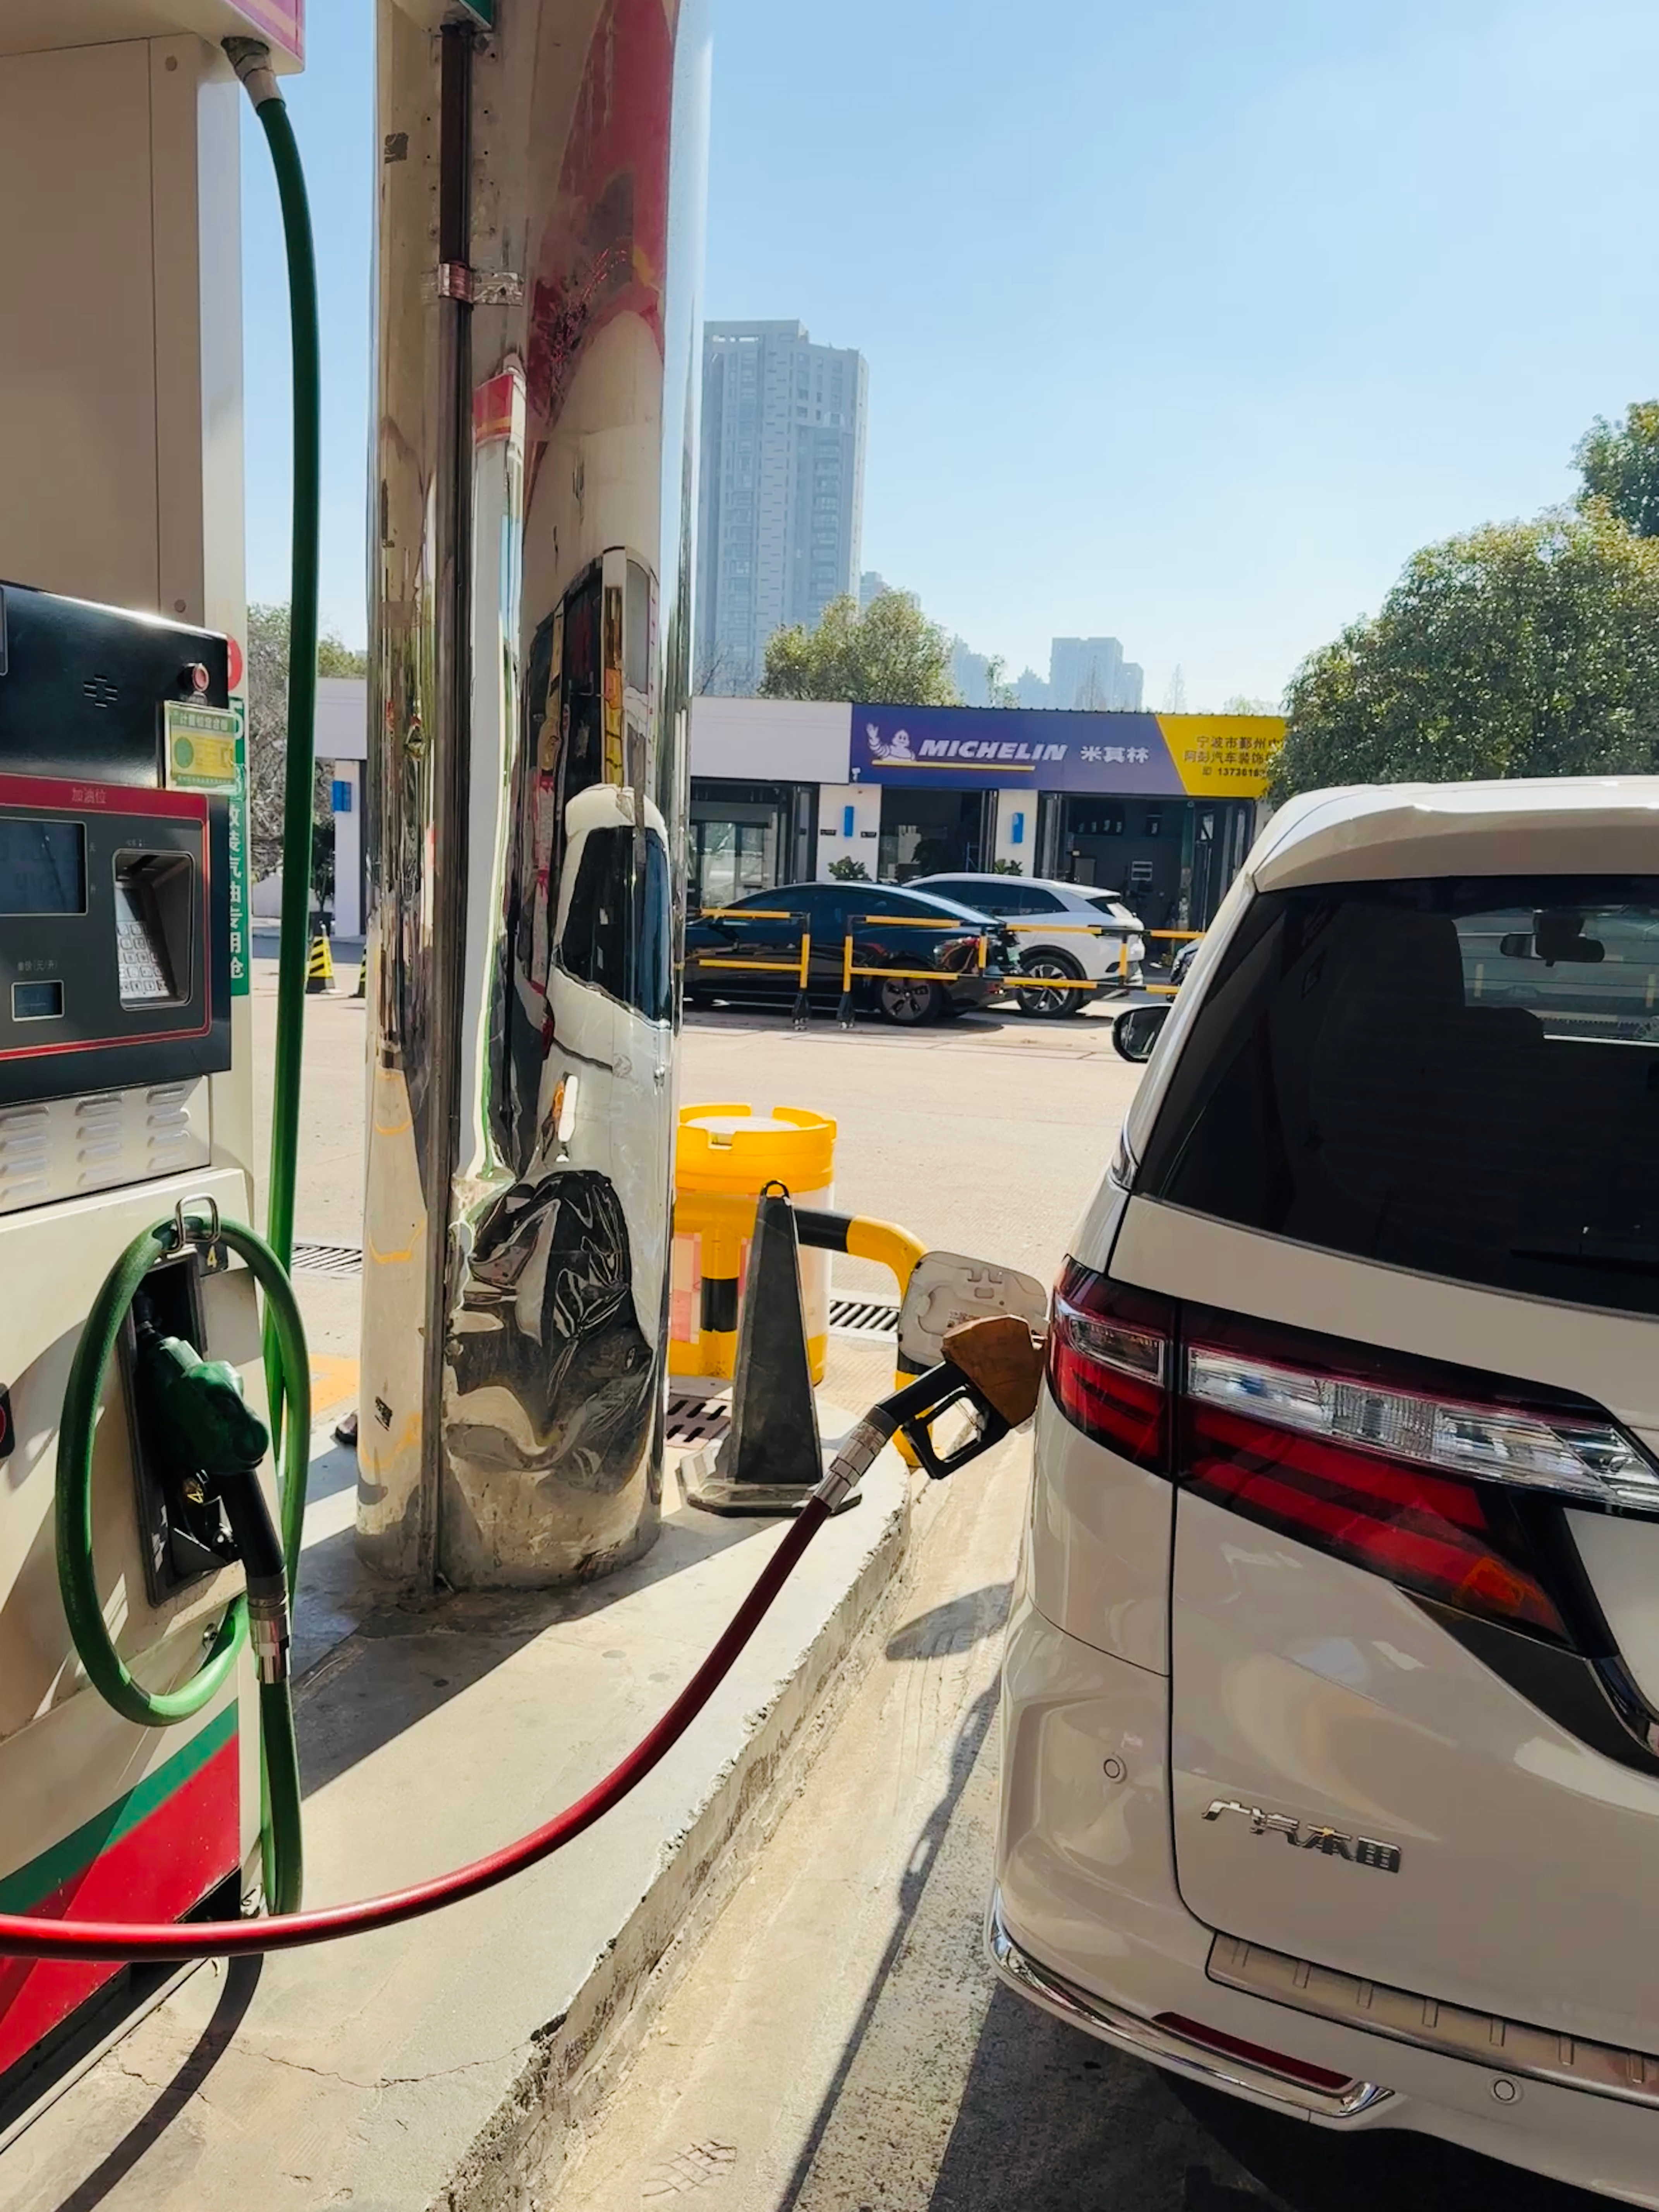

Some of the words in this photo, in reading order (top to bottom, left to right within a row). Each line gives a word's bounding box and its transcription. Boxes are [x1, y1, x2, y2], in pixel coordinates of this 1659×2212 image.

[919, 739, 1068, 761] MICHELIN
[1080, 745, 1149, 763] 米其林
[207, 1245, 217, 1268] 4
[1202, 1799, 1401, 1873] 广汽本田
